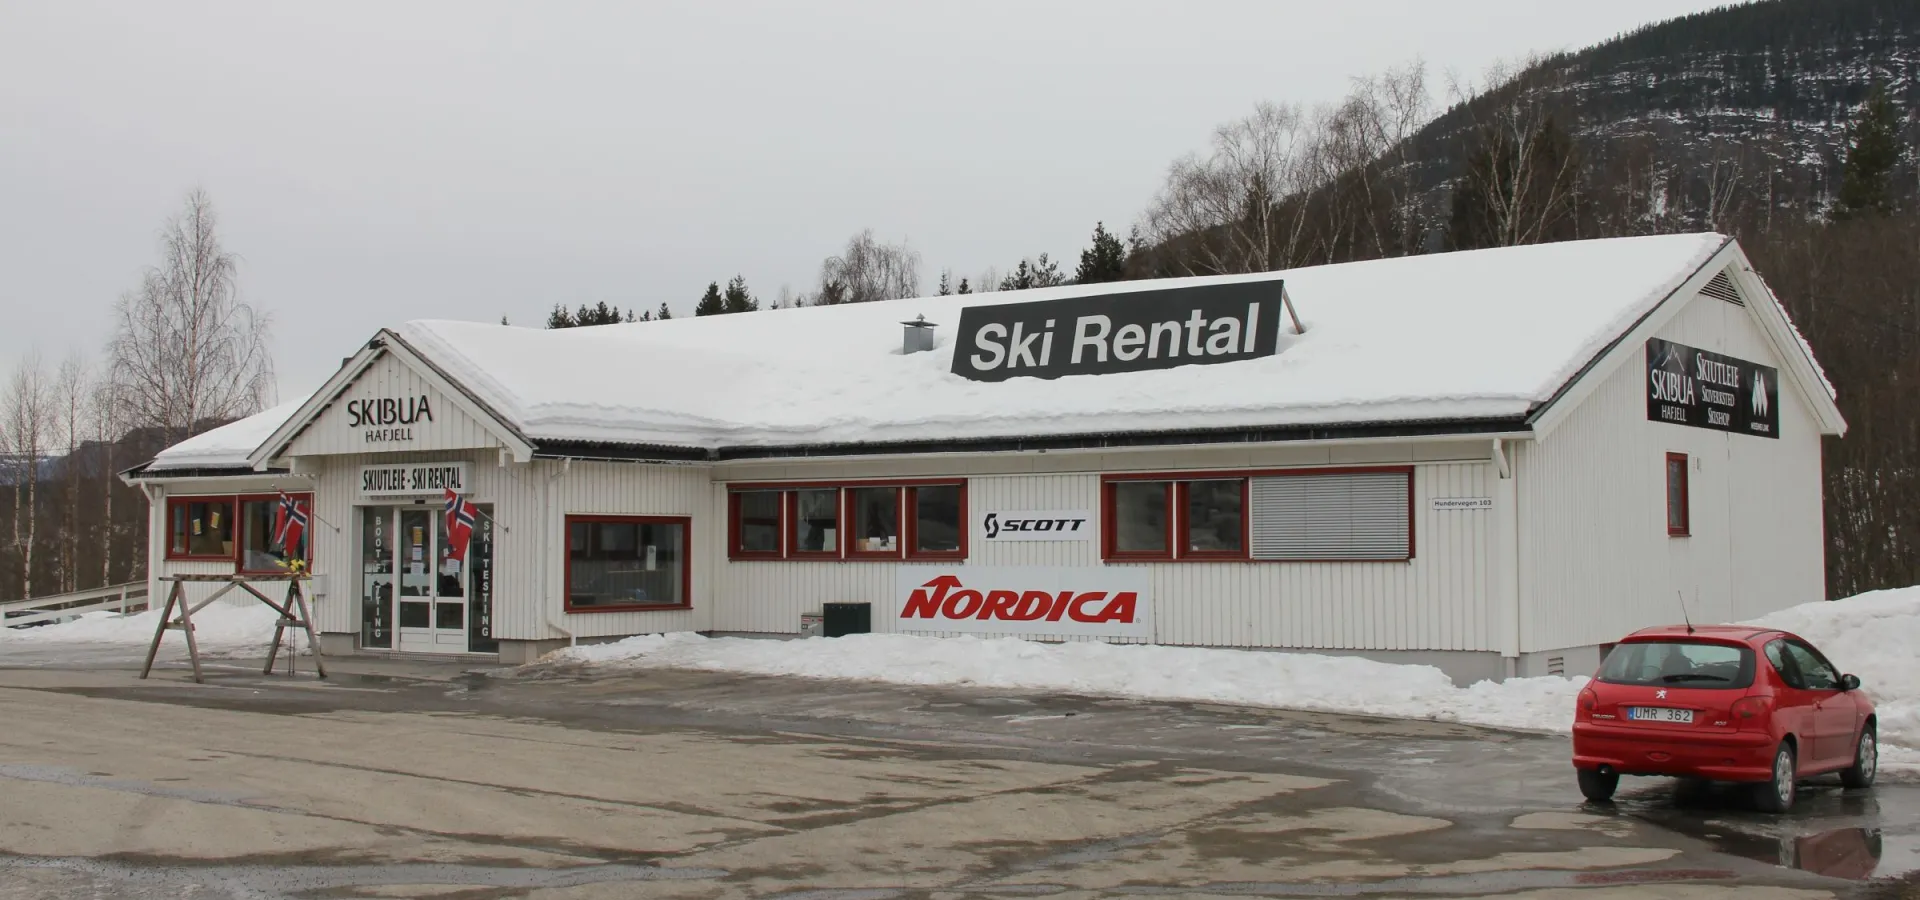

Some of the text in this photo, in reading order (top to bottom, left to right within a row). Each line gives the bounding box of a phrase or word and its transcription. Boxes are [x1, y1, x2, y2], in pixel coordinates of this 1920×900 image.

[970, 302, 1260, 371] Ski Rental
[1696, 352, 1739, 388] SKIUTLEIE
[1651, 368, 1696, 406] SKIBUA
[347, 395, 433, 428] SKIBUA
[1661, 405, 1687, 422] HAFJELL
[365, 428, 413, 443] HAFJELL
[363, 468, 406, 491] SKIUTLEIE
[412, 467, 426, 490] SKI
[428, 466, 461, 489] RENTAL
[1001, 518, 1086, 532] SCOTT
[481, 559, 490, 638] TESTING
[900, 575, 1138, 623] NORDICA
[1635, 707, 1691, 721] UMR 362
